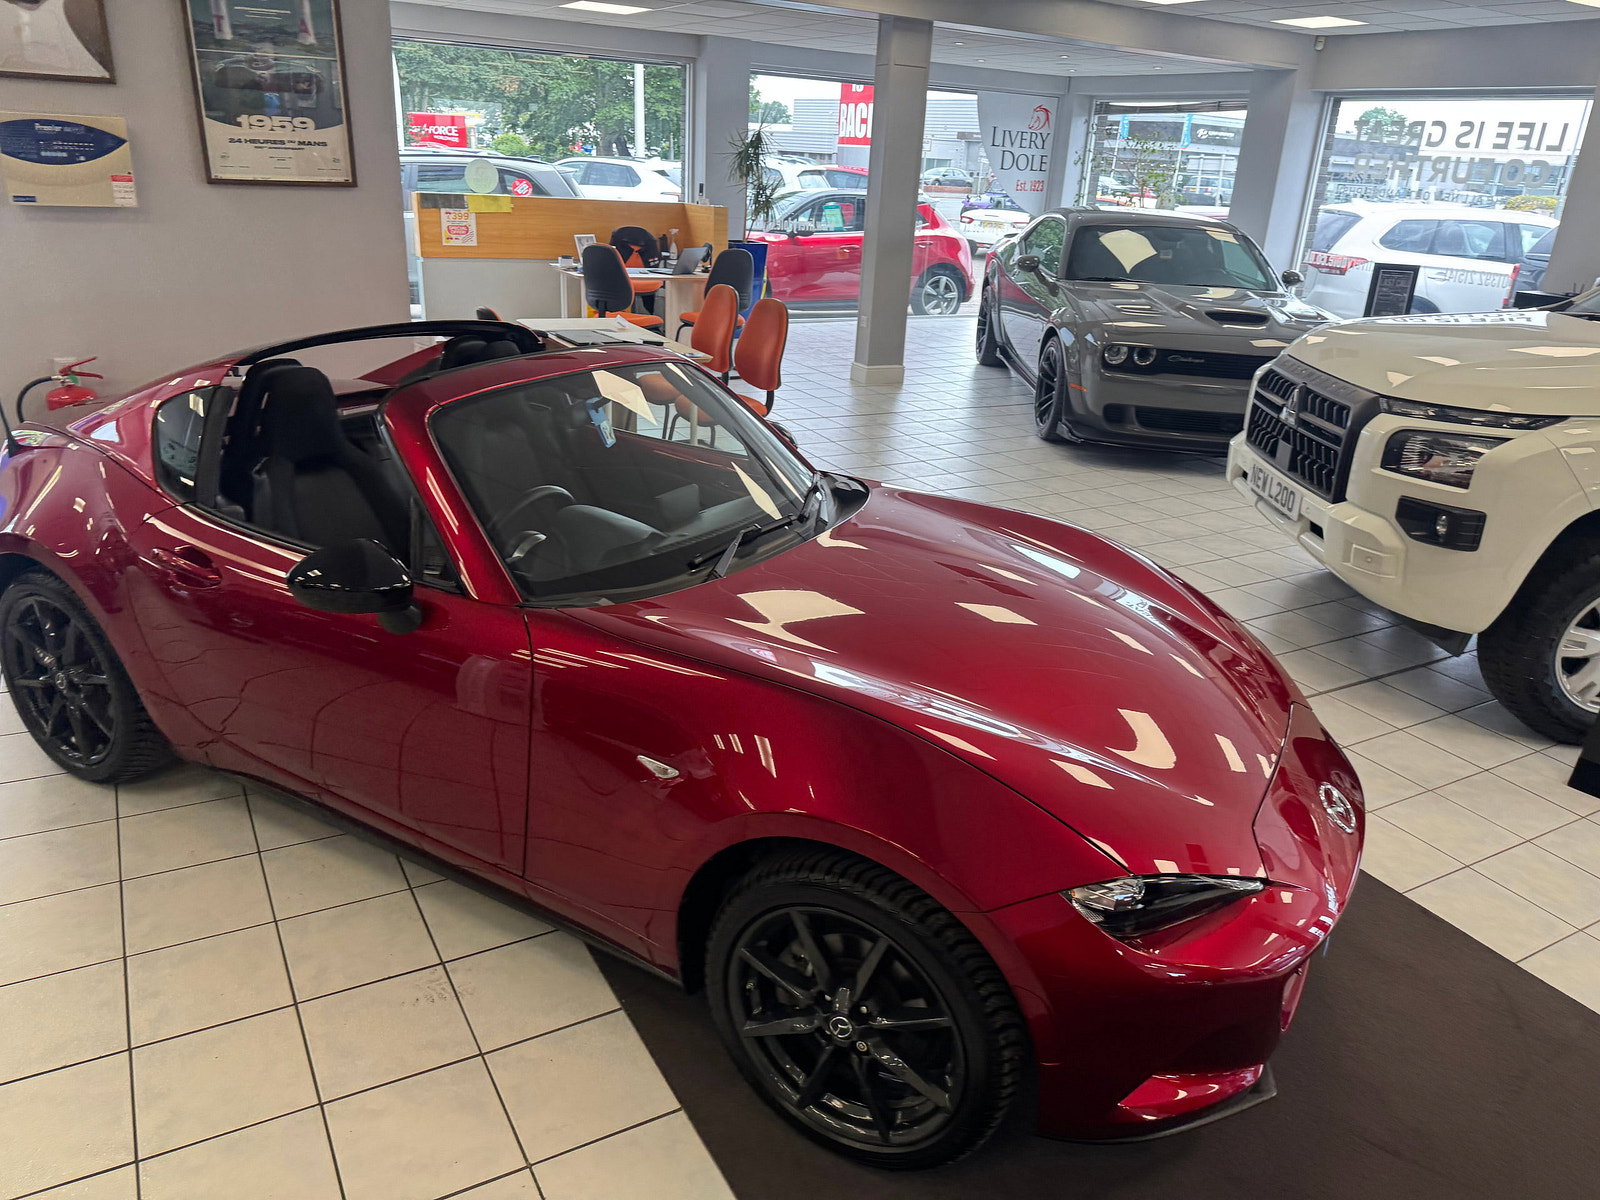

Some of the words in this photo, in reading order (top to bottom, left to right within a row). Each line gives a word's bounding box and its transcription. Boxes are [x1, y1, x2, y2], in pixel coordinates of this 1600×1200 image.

[235, 114, 315, 132] 1959
[990, 125, 1051, 150] LIVERY
[1000, 149, 1049, 172] DOLE
[1250, 463, 1270, 493] NEW
[1268, 476, 1296, 512] L200
